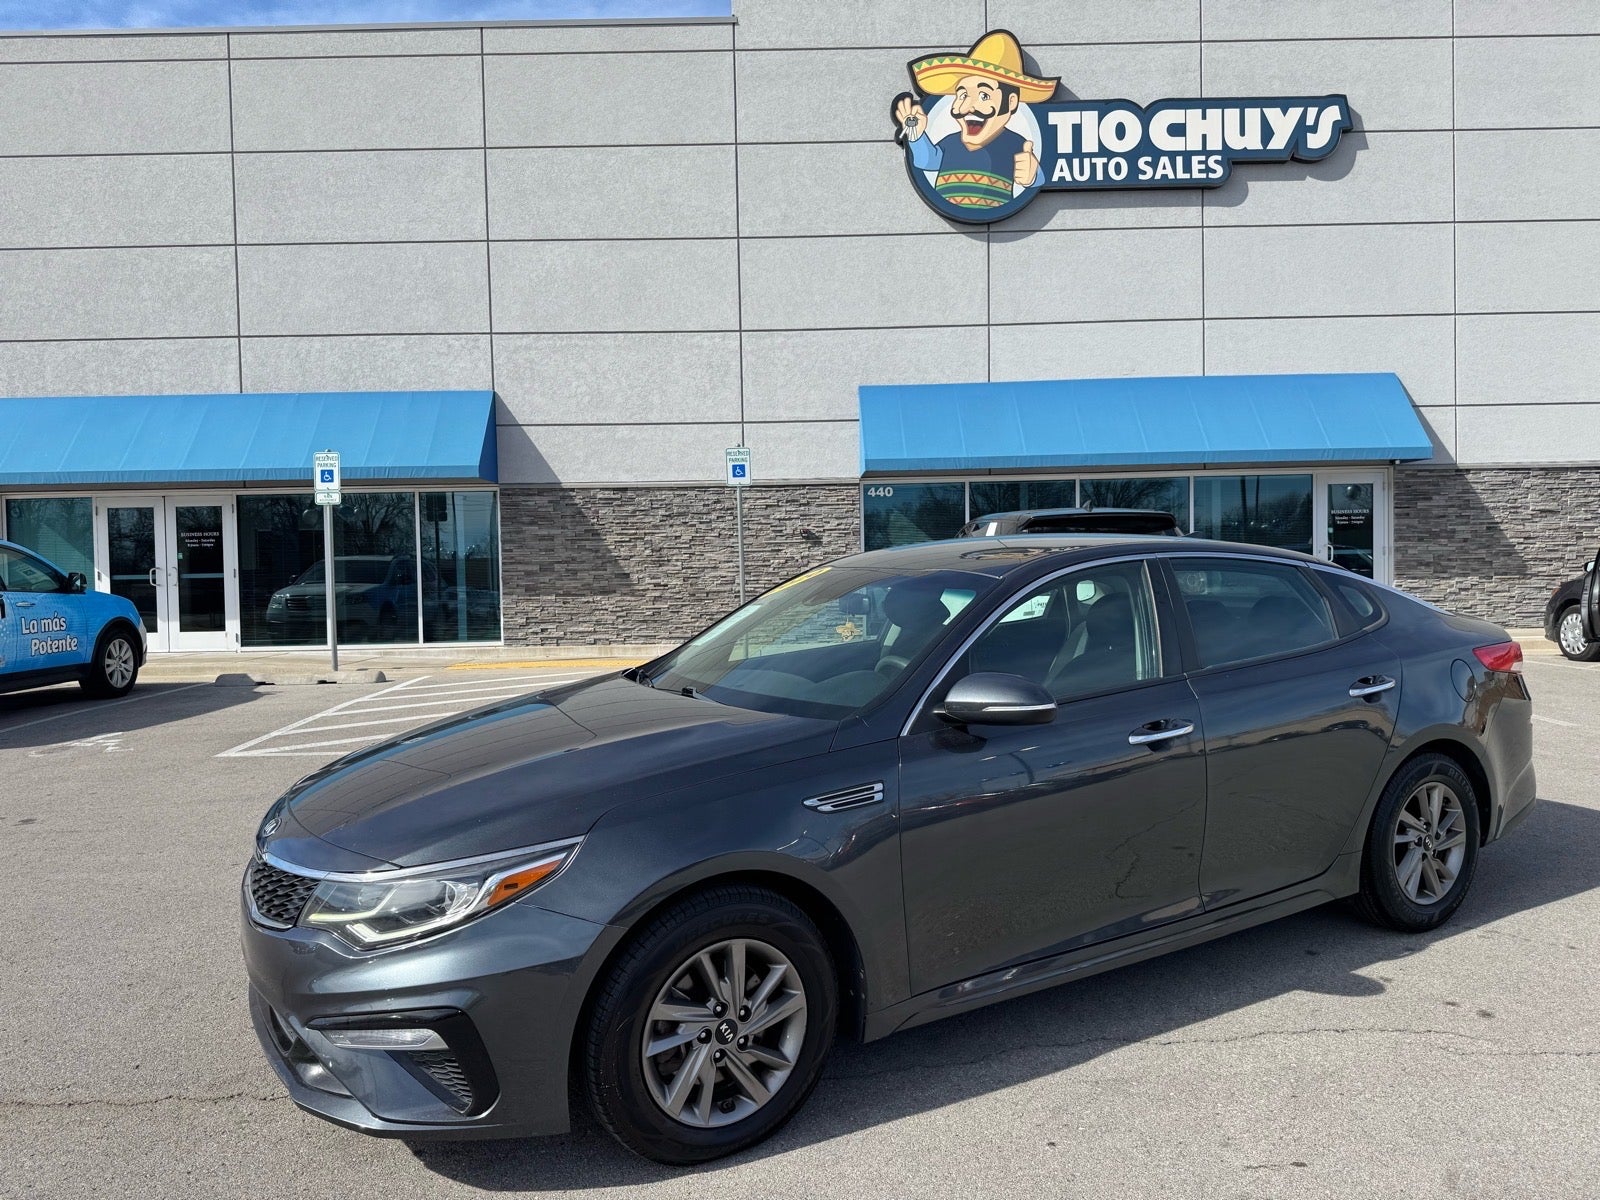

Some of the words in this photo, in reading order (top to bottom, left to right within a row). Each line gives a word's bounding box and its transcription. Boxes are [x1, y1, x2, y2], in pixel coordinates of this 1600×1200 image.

[1048, 109, 1142, 153] TIO
[1149, 105, 1342, 151] CHUY'S
[1051, 156, 1129, 182] AUTO
[1138, 155, 1224, 180] SALES
[867, 486, 894, 498] 440
[21, 617, 38, 634] La
[41, 611, 67, 633] más
[31, 634, 78, 656] Potente
[719, 1022, 734, 1043] KIA
